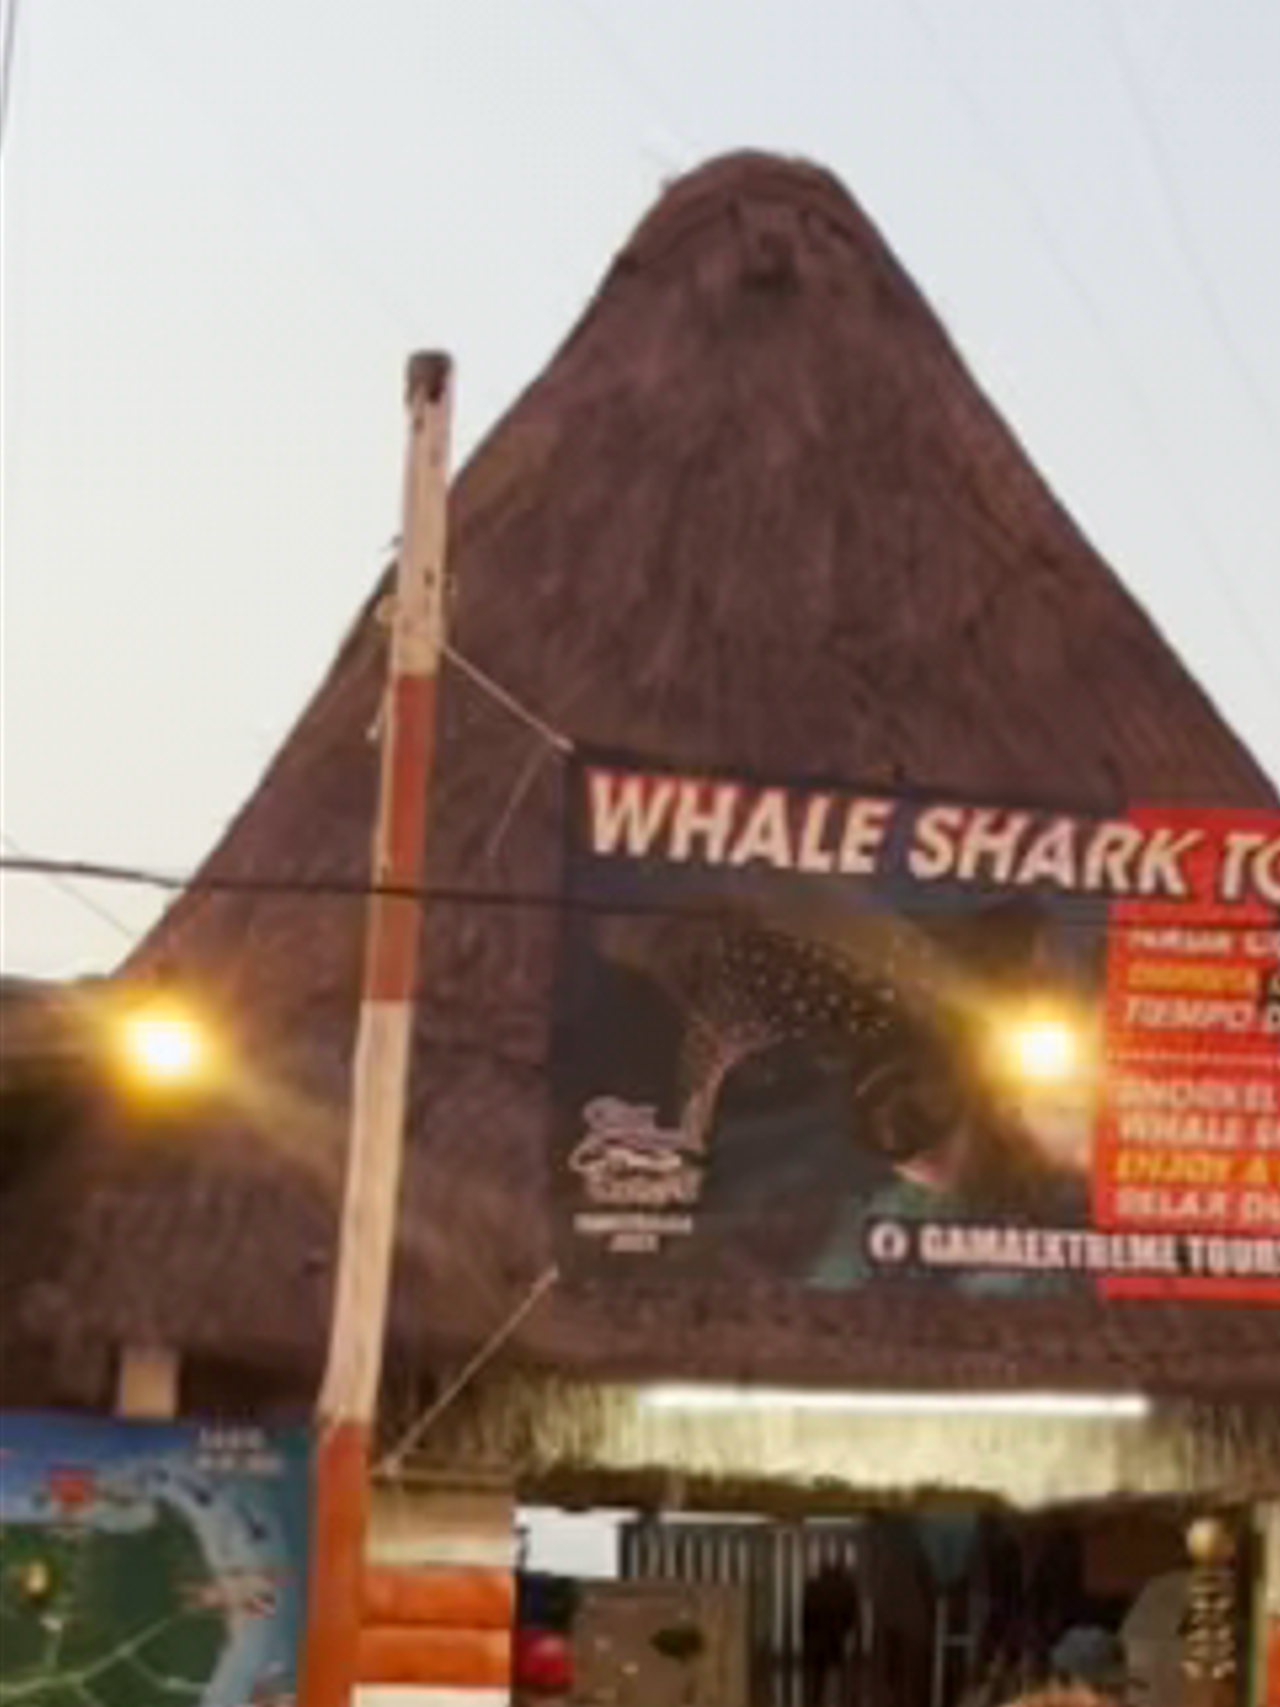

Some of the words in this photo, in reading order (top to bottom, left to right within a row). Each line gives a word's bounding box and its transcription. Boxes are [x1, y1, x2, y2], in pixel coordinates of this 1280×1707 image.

[586, 768, 894, 876] WHALE
[908, 801, 1202, 897] SHARK
[1126, 996, 1254, 1029] TIEMPO
[1117, 1080, 1276, 1112] SNORKEL
[1118, 1112, 1238, 1145] WHALE
[1117, 1150, 1233, 1185] ENJOY
[1116, 1191, 1227, 1220] RELAX
[919, 1225, 1178, 1273] GAMAEXTREME
